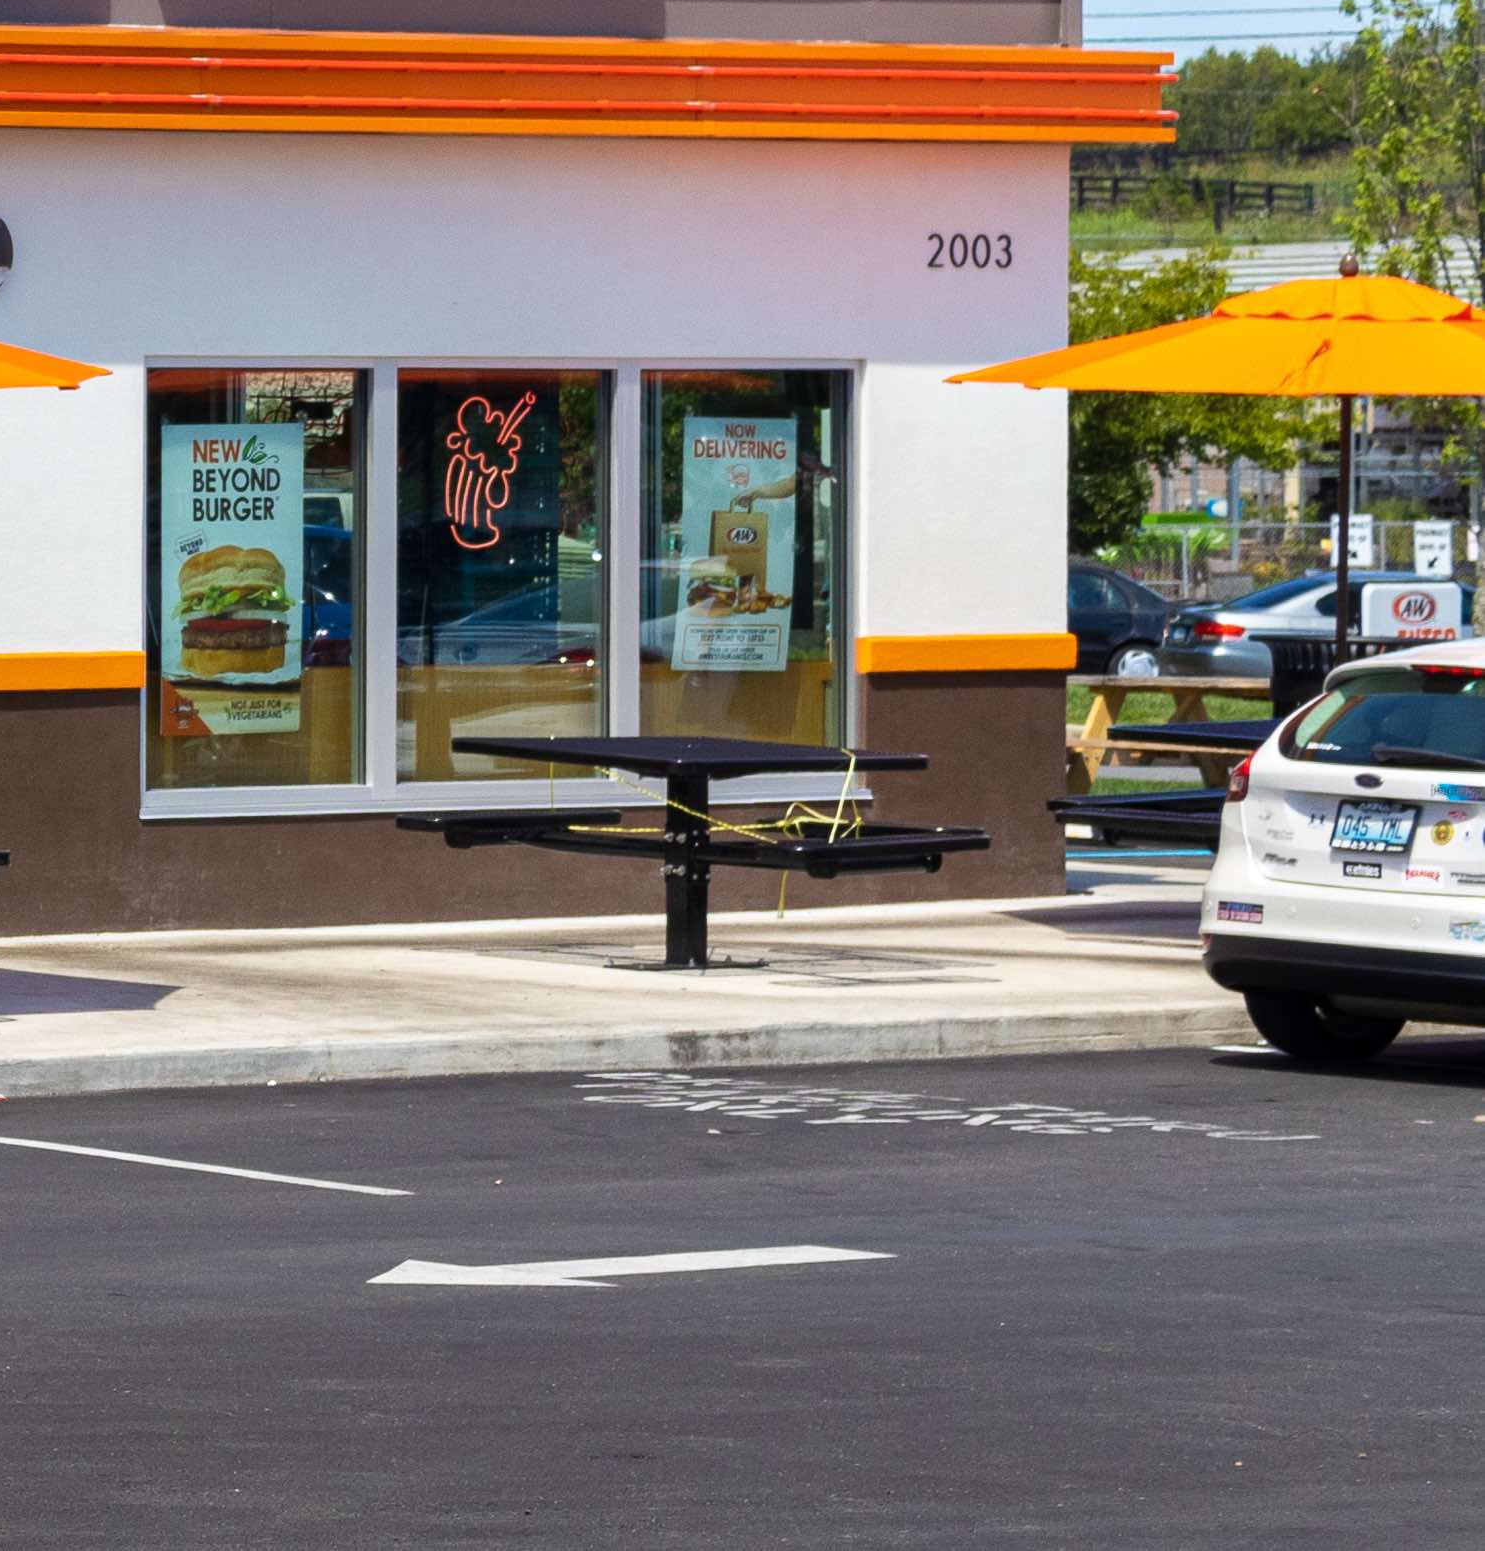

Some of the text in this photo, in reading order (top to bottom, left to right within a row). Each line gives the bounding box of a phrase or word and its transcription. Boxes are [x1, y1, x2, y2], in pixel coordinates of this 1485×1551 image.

[926, 233, 1014, 270] 2003
[724, 424, 756, 438] NOW
[193, 439, 241, 463] NEW
[693, 439, 787, 460] DELIVERING
[193, 468, 281, 493] BEYOND
[193, 496, 275, 522] BURGER
[232, 710, 283, 721] VEGETARIANS
[1341, 814, 1371, 837] 045
